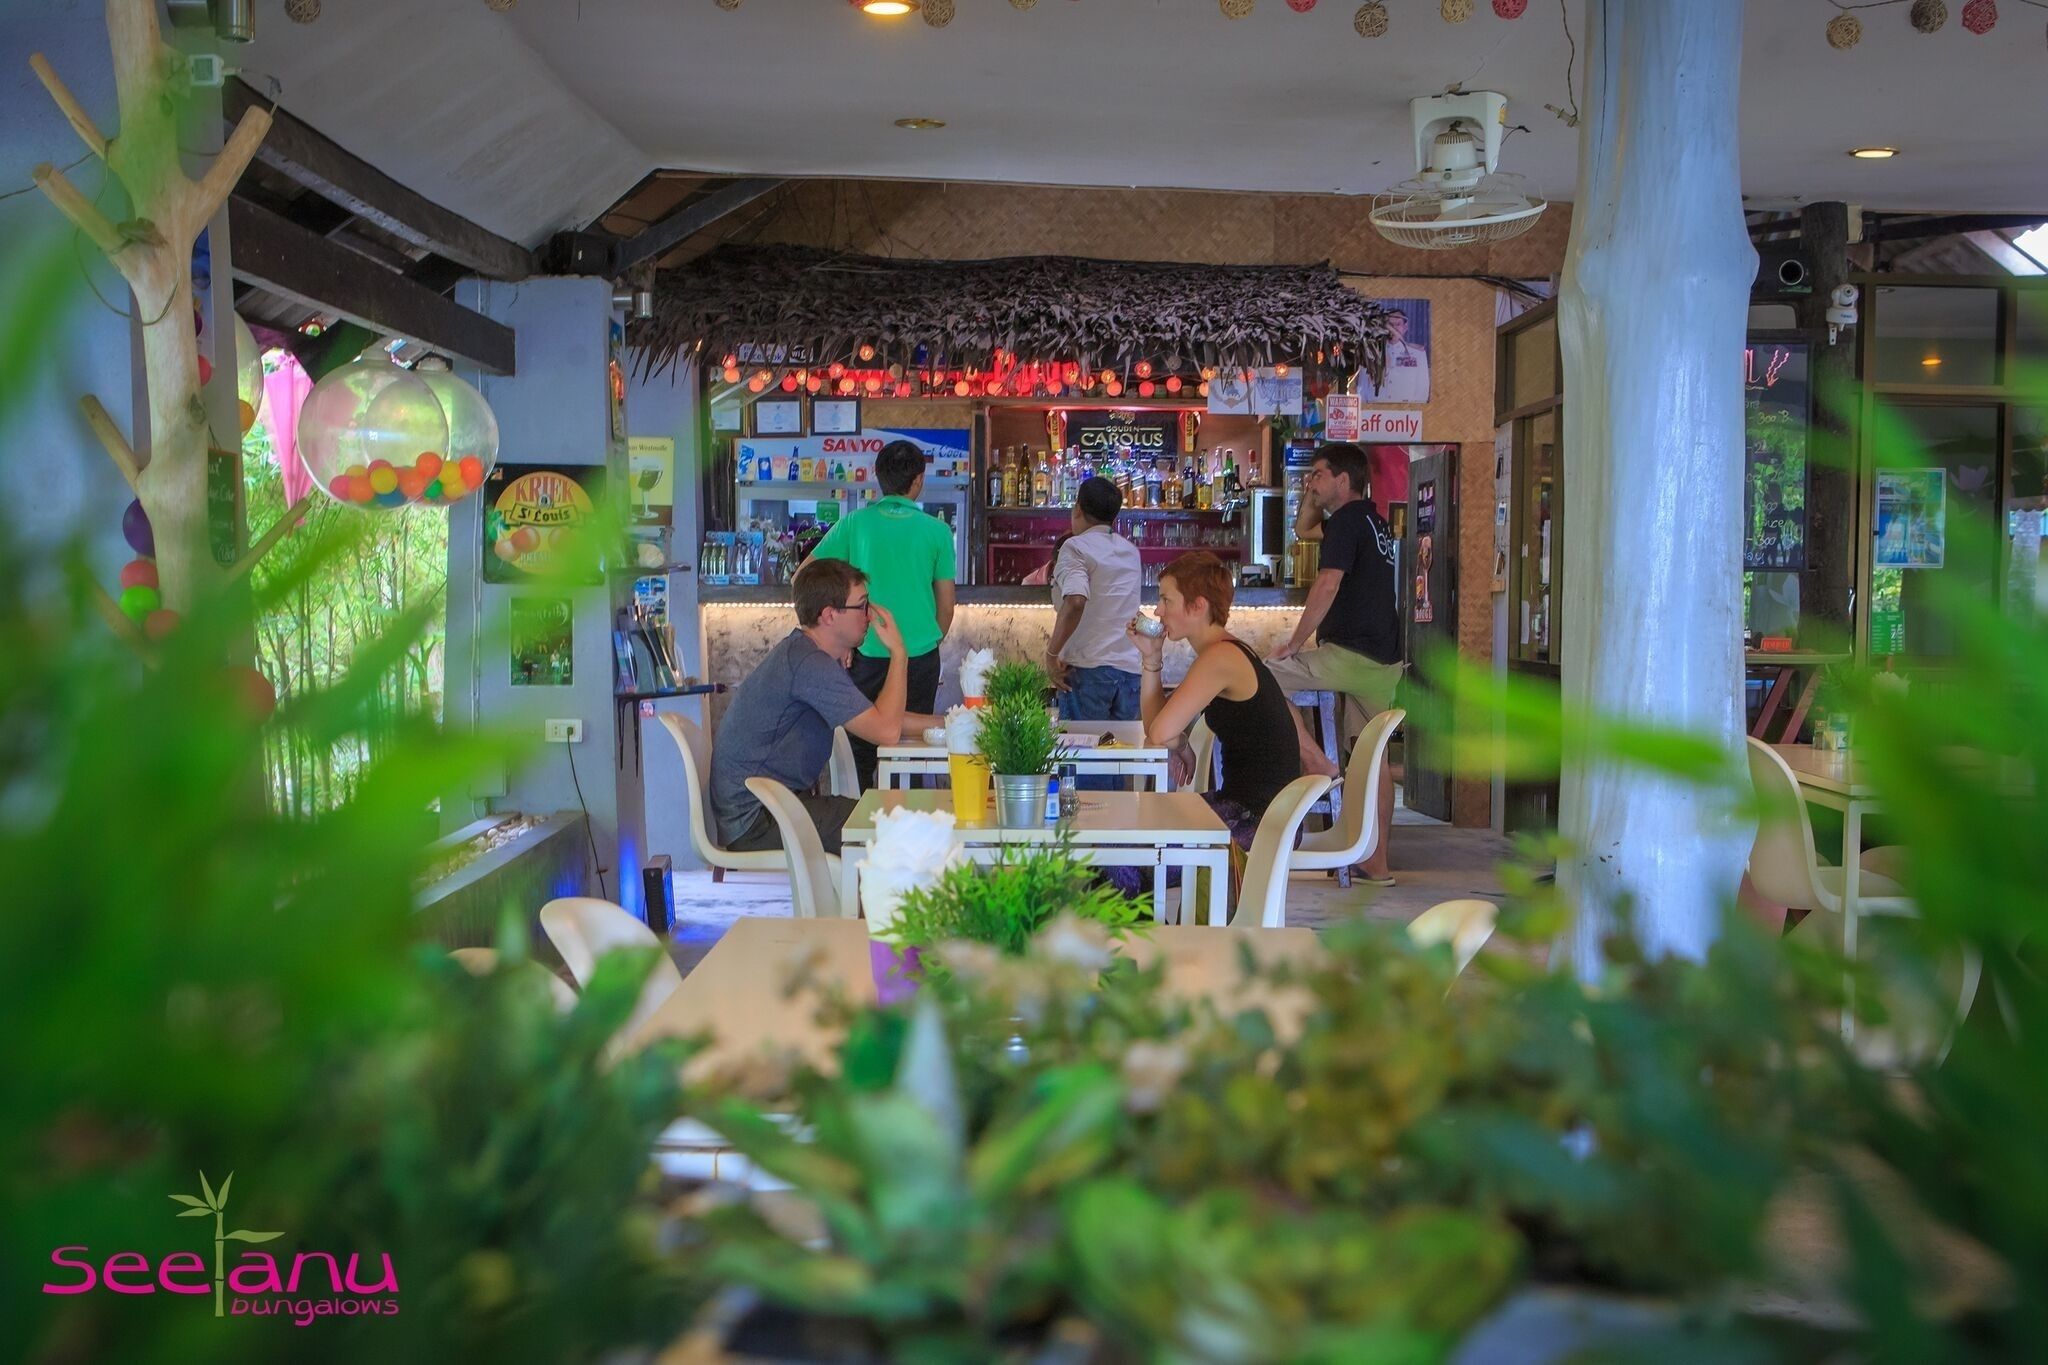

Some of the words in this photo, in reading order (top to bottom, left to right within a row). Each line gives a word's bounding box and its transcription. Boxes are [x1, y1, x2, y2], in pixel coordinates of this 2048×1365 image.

[1361, 414, 1382, 432] aff
[1385, 415, 1419, 438] only
[822, 438, 884, 453] SANYO
[1080, 432, 1164, 447] CAROLUS
[515, 475, 574, 503] KRIEK
[533, 509, 571, 522] Louis
